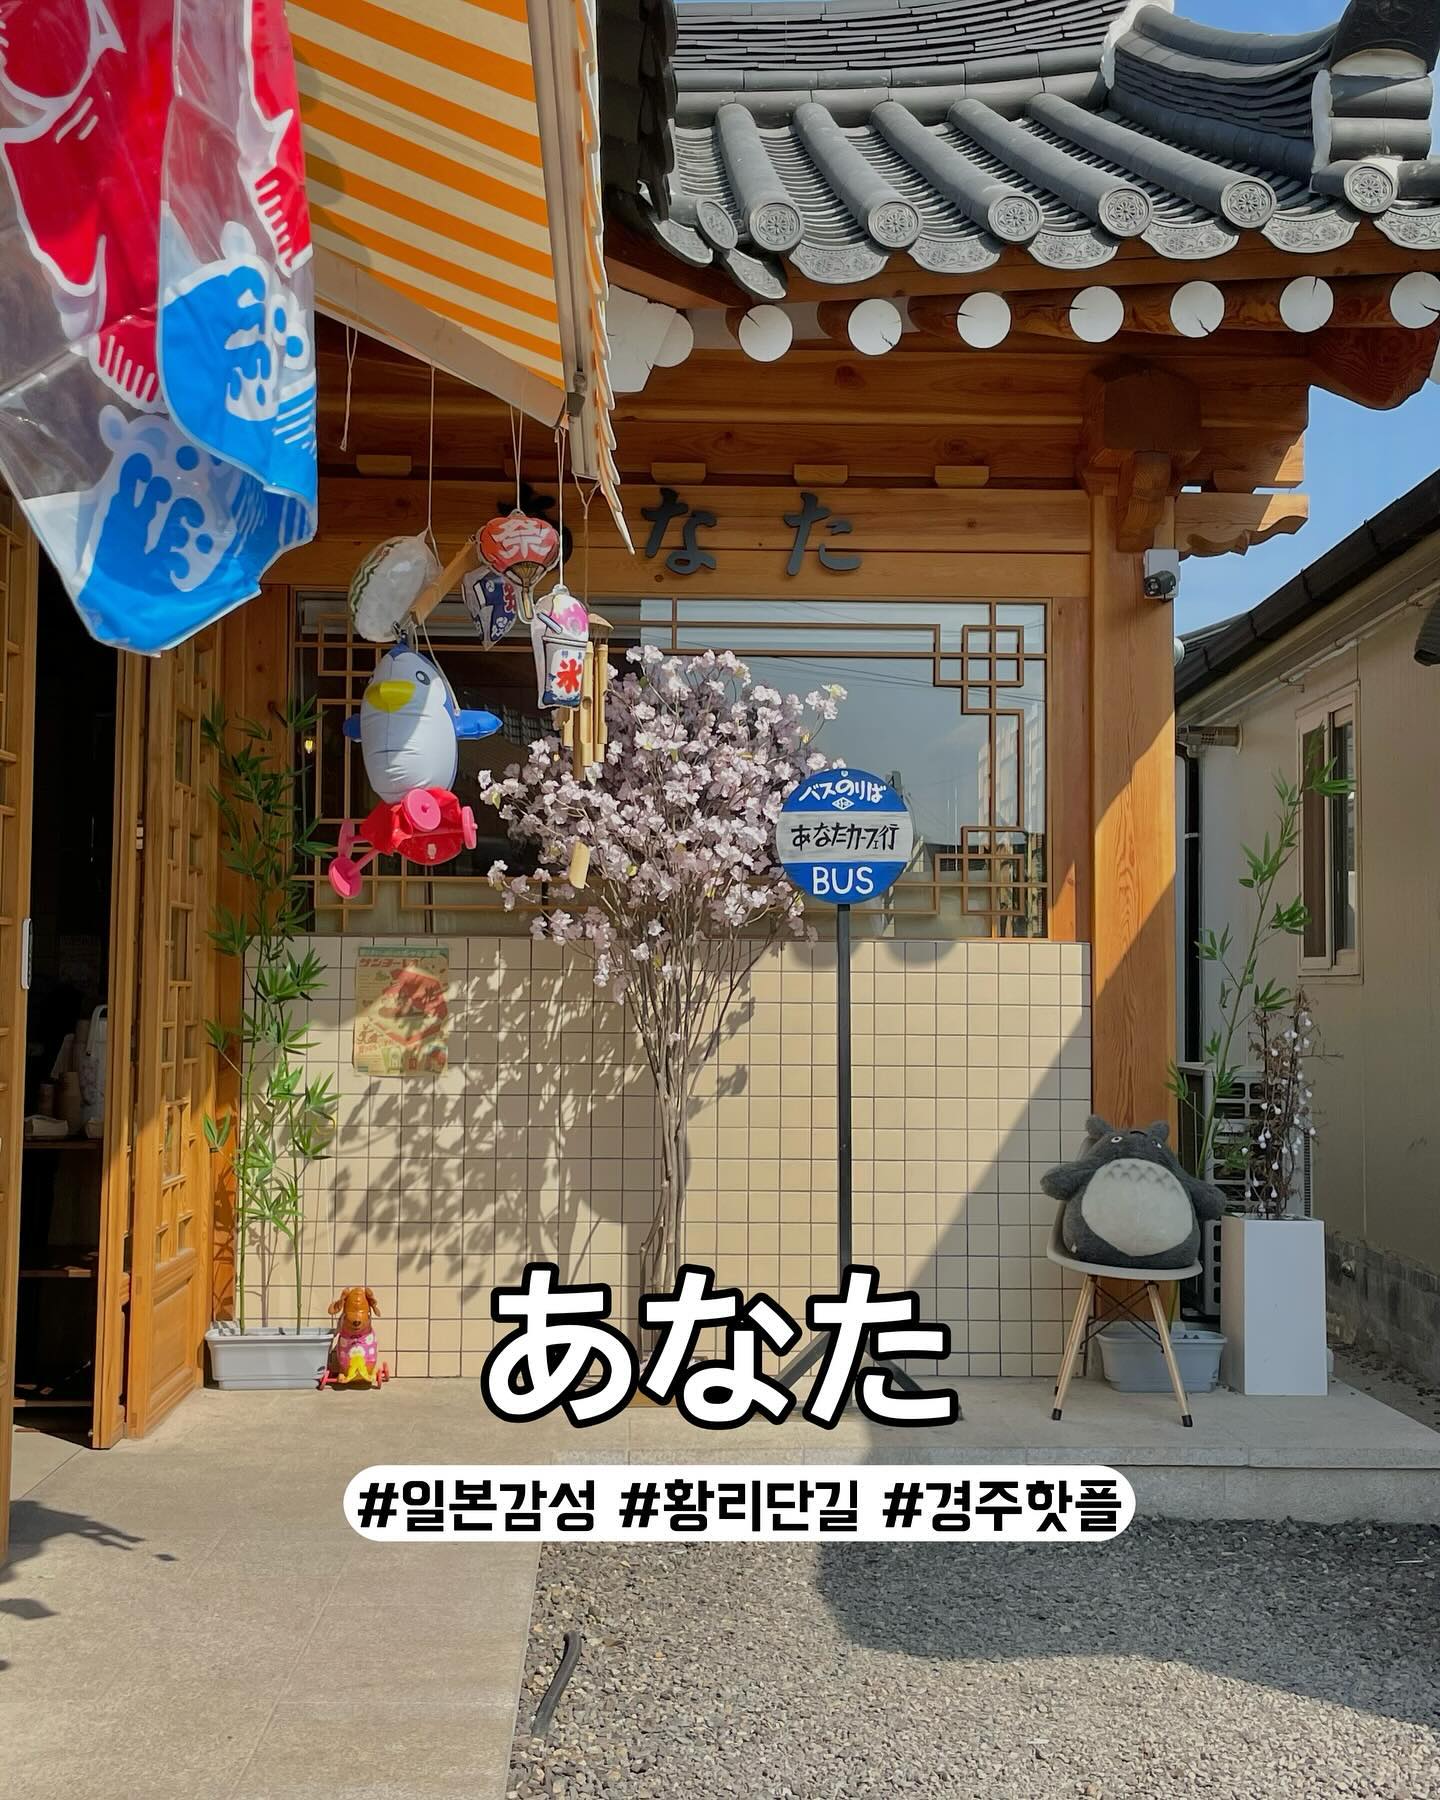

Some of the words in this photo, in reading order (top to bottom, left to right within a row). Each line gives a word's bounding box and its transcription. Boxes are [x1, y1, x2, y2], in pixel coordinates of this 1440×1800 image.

[556, 658, 583, 695] 氷
[798, 779, 887, 803] バスのりば
[812, 866, 874, 895] BUS
